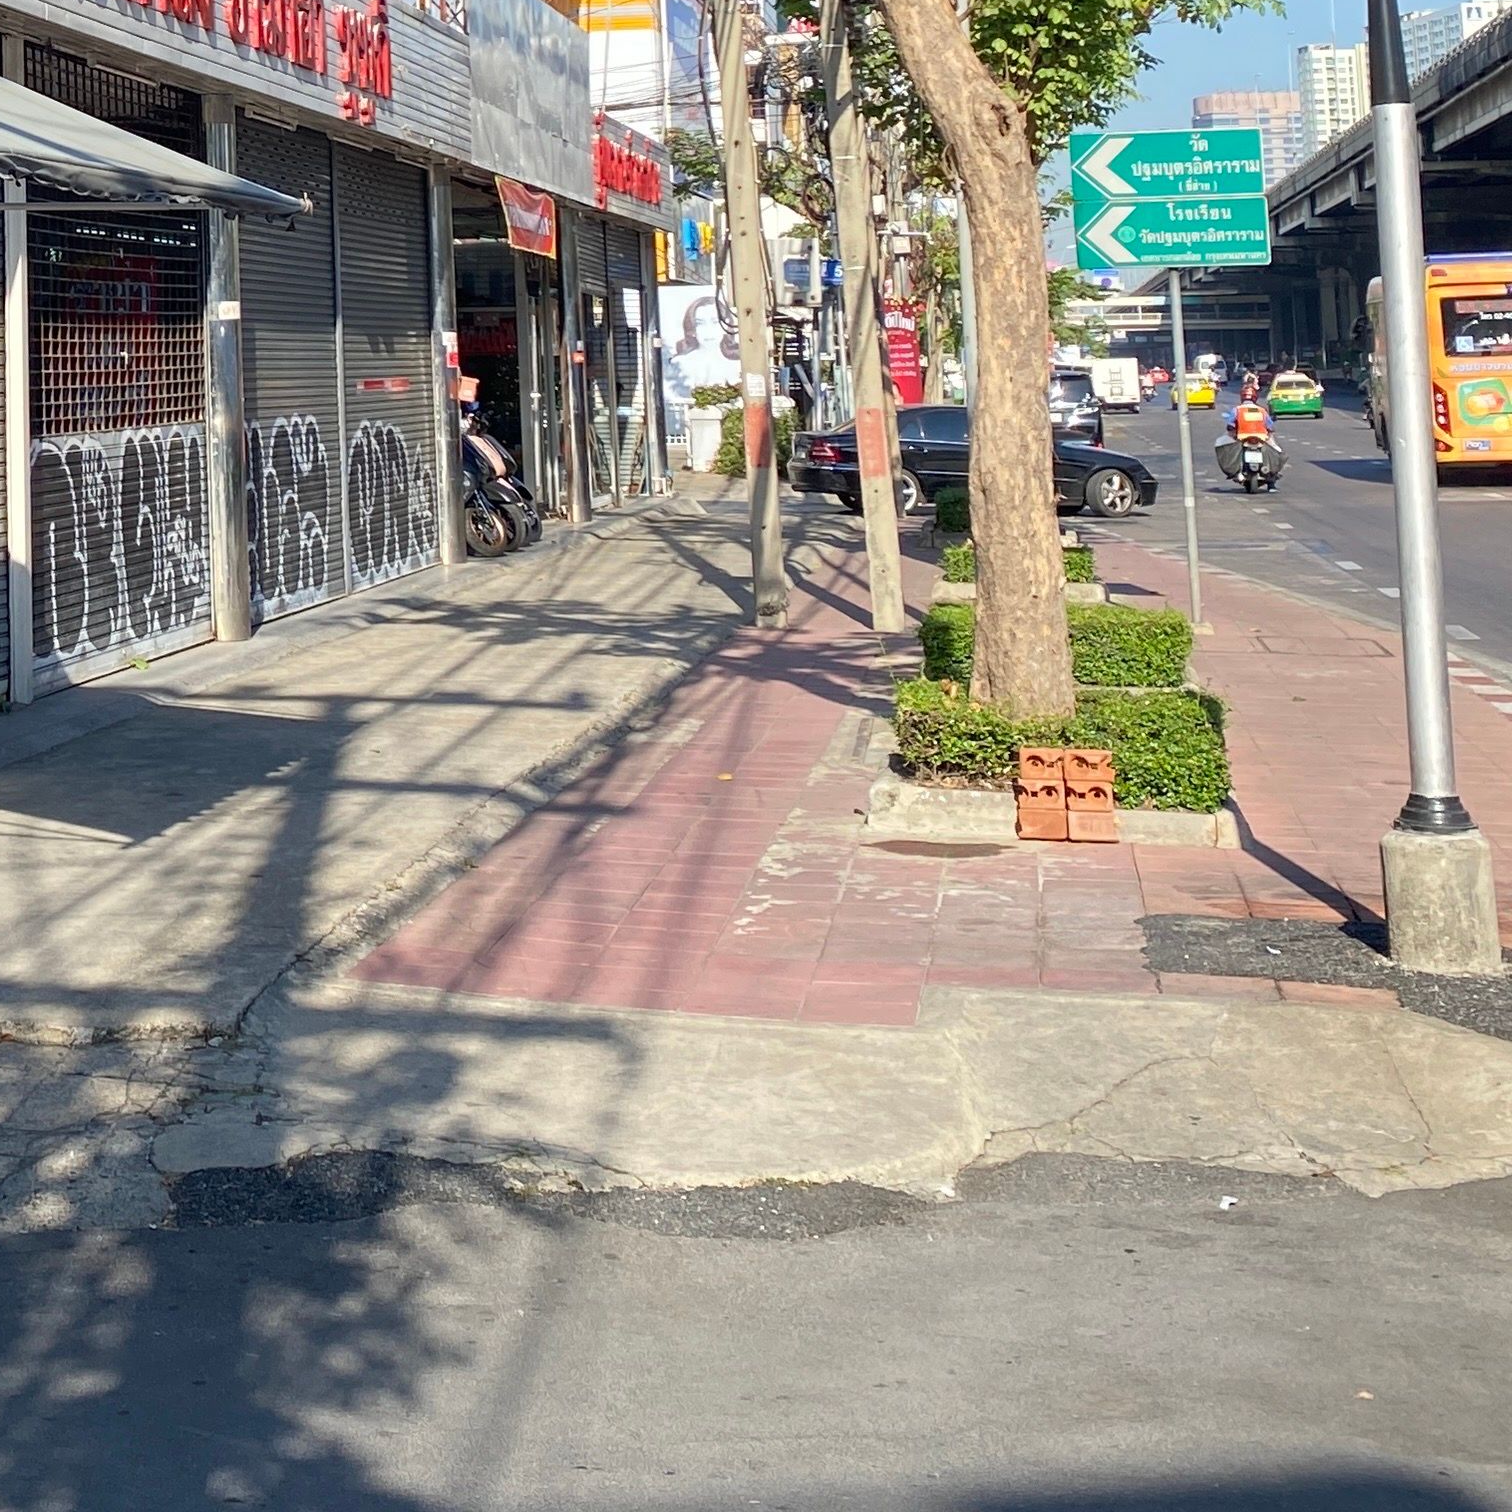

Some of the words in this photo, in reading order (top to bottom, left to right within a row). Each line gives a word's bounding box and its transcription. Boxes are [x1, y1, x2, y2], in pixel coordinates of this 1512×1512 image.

[1189, 133, 1209, 152] วัด
[1131, 156, 1260, 181] ปฐมบุตรอิศราราม
[1166, 202, 1232, 221] โรงเรียน
[1138, 227, 1264, 247] วัดปฐมบุตรอิศราราม
